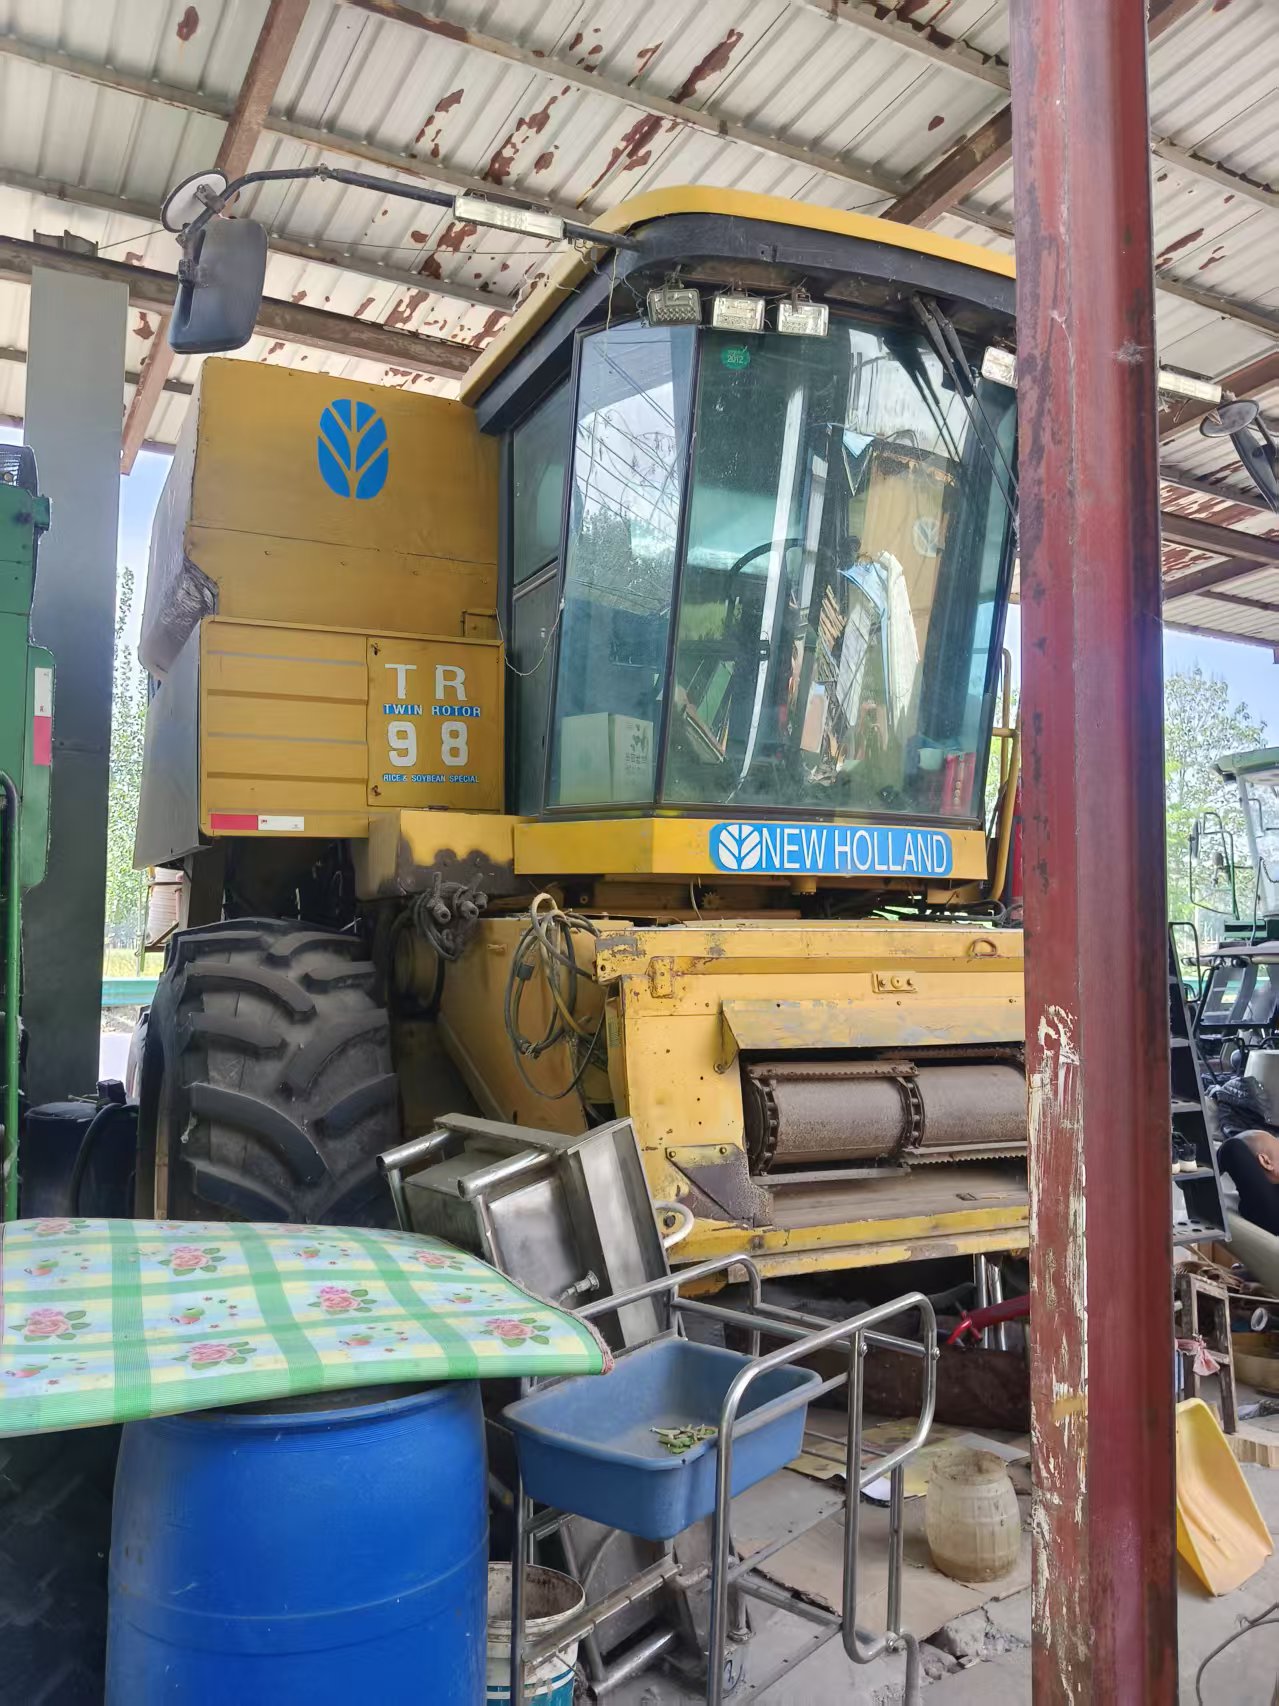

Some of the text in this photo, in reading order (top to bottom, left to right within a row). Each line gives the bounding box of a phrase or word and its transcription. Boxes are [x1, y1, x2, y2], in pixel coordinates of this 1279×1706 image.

[384, 704, 480, 716] TWIN ROTOR
[411, 774, 446, 783] SOYBEAN
[449, 775, 480, 783] SPECIAL
[761, 827, 948, 874] NEW HOLLAND
